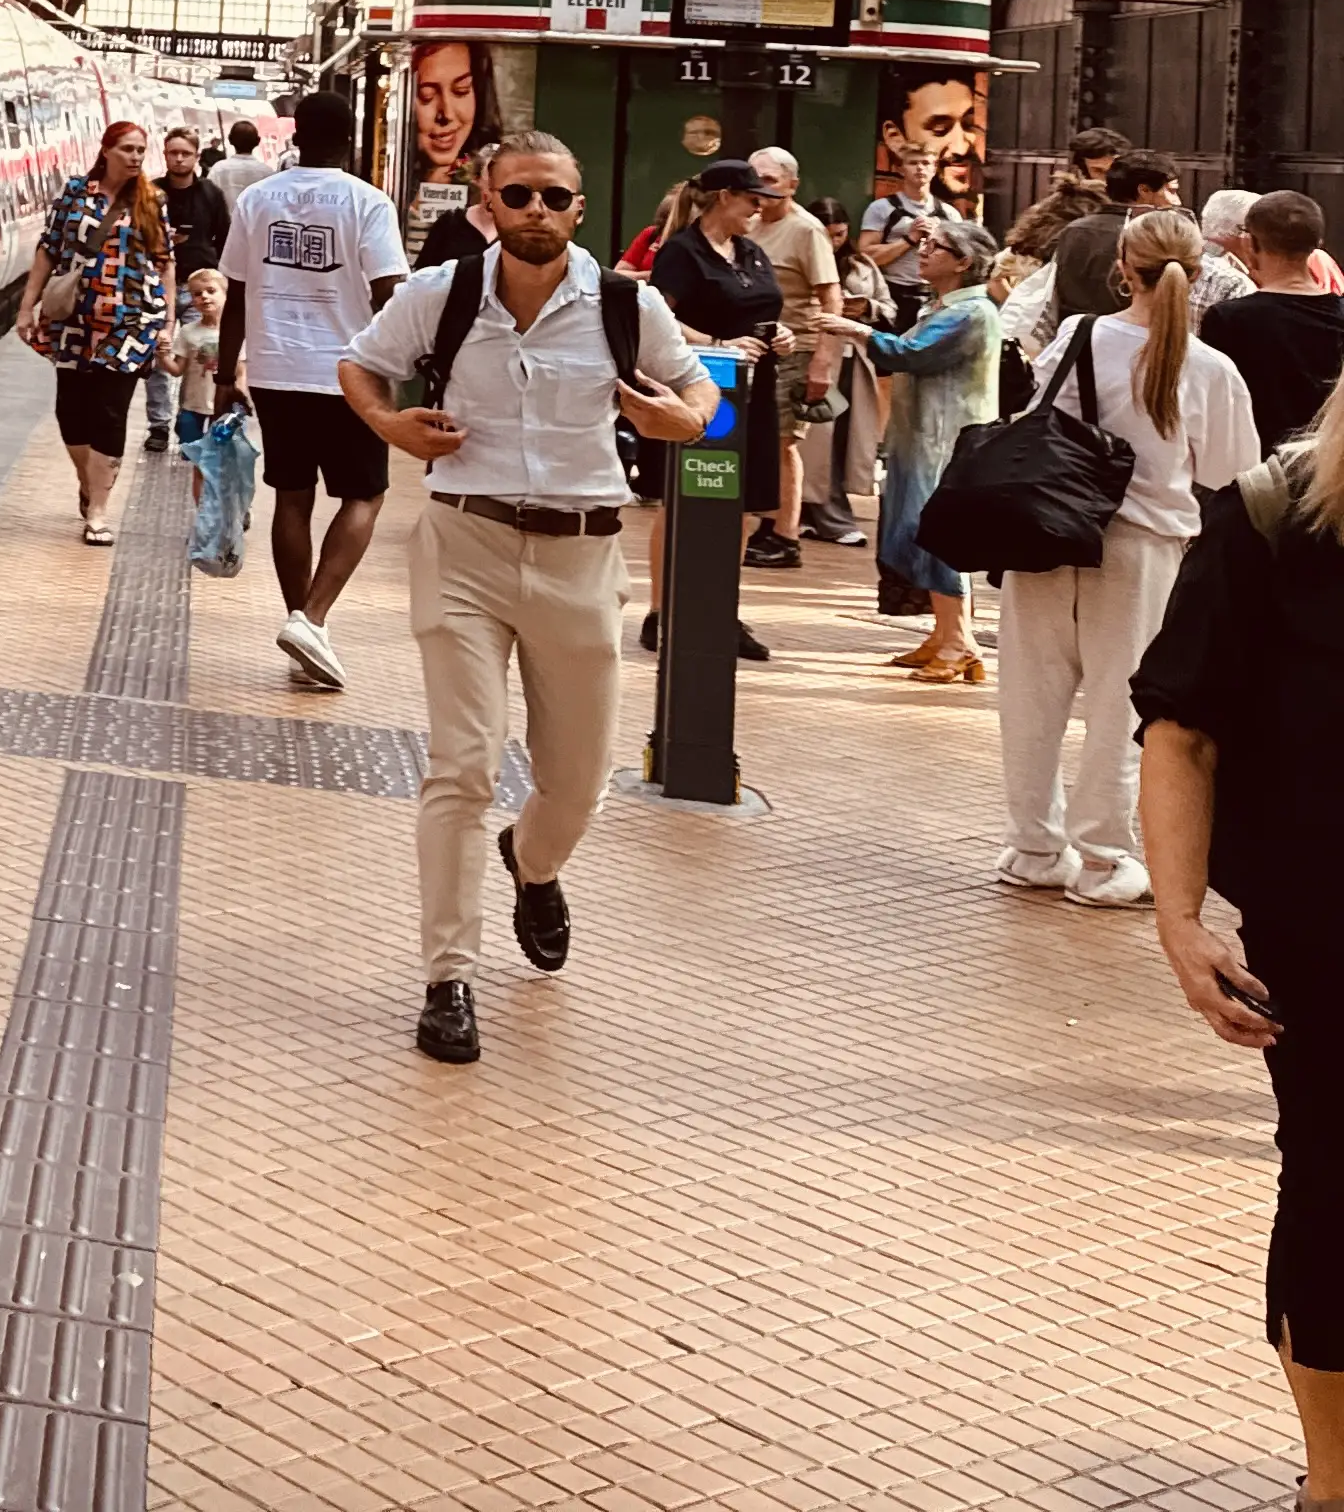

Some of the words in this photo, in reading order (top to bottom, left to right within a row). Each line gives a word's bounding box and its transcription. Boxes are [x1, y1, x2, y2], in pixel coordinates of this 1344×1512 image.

[680, 61, 712, 81] 11
[779, 65, 811, 86] 12
[685, 458, 736, 473] Check
[697, 474, 724, 488] ind
